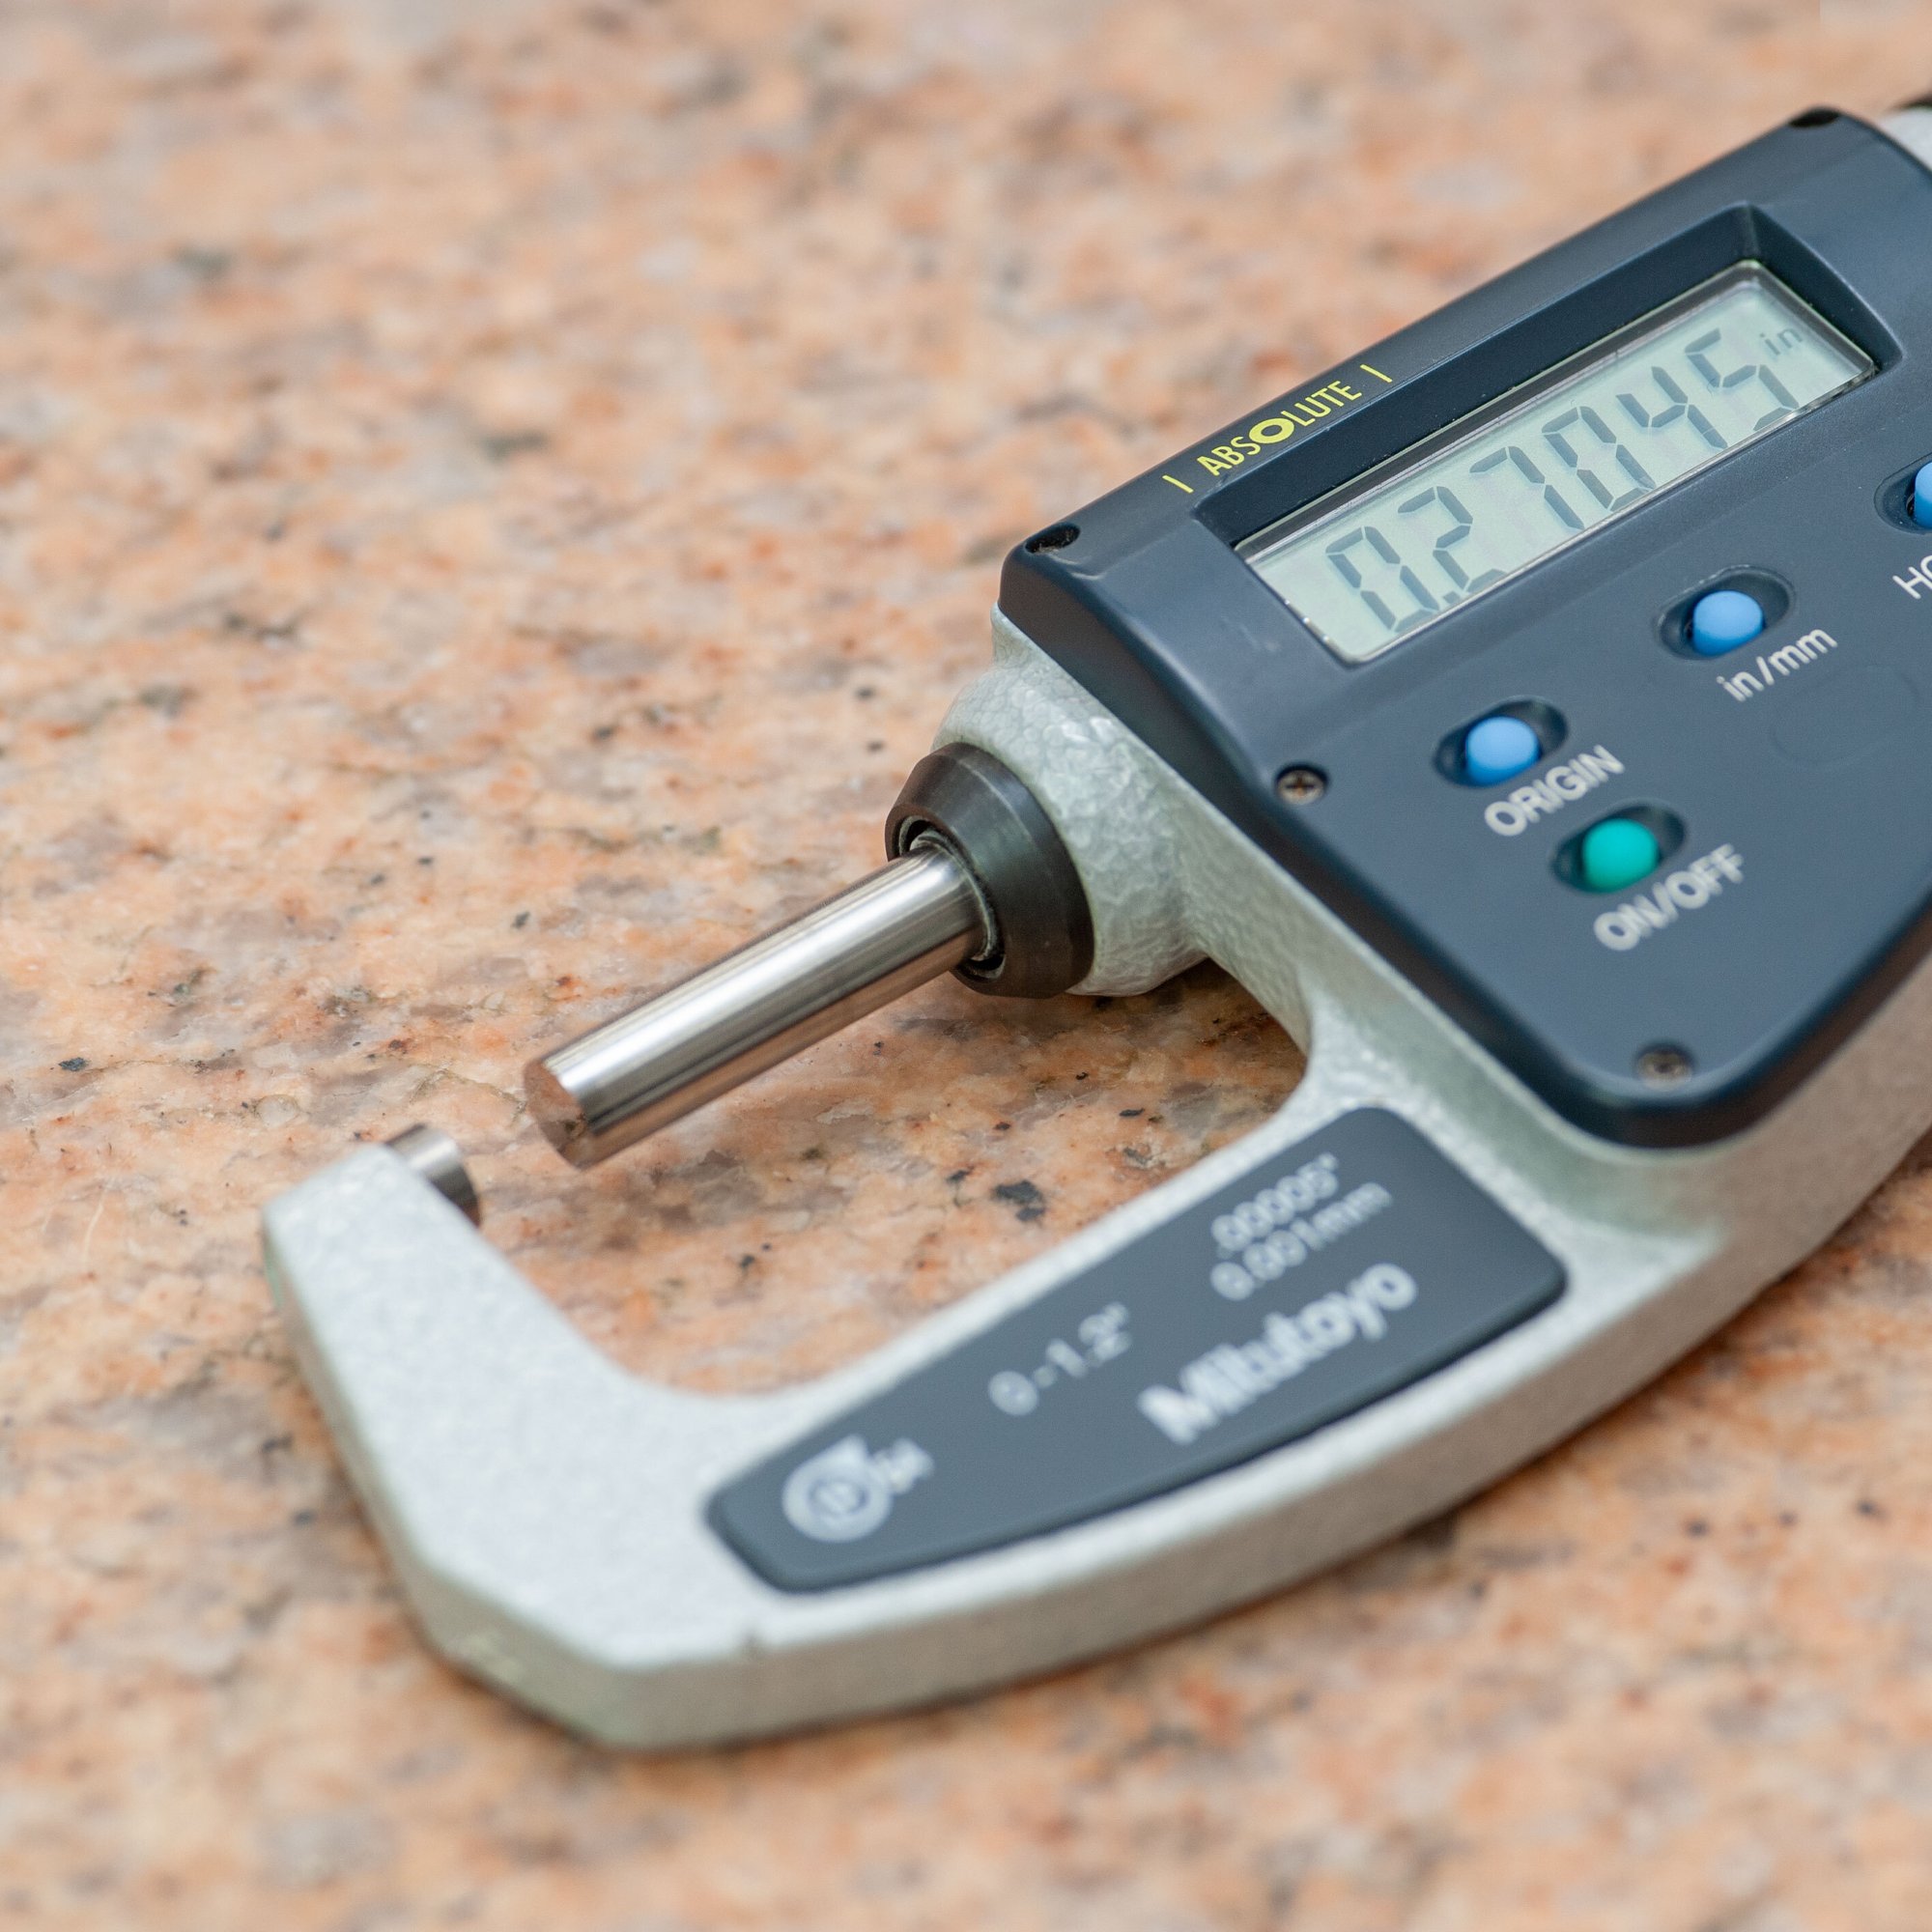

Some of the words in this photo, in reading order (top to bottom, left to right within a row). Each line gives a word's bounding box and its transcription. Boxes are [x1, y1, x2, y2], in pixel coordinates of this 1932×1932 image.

[1197, 381, 1362, 476] ABSOLUTE
[1325, 328, 1800, 634] 0.27045
[1758, 327, 1804, 357] in
[1717, 628, 1838, 702] in/mm
[1484, 744, 1625, 837] ORIGIN
[1593, 842, 1745, 952] ON/OFF
[1137, 1263, 1419, 1445] Mitutoyo
